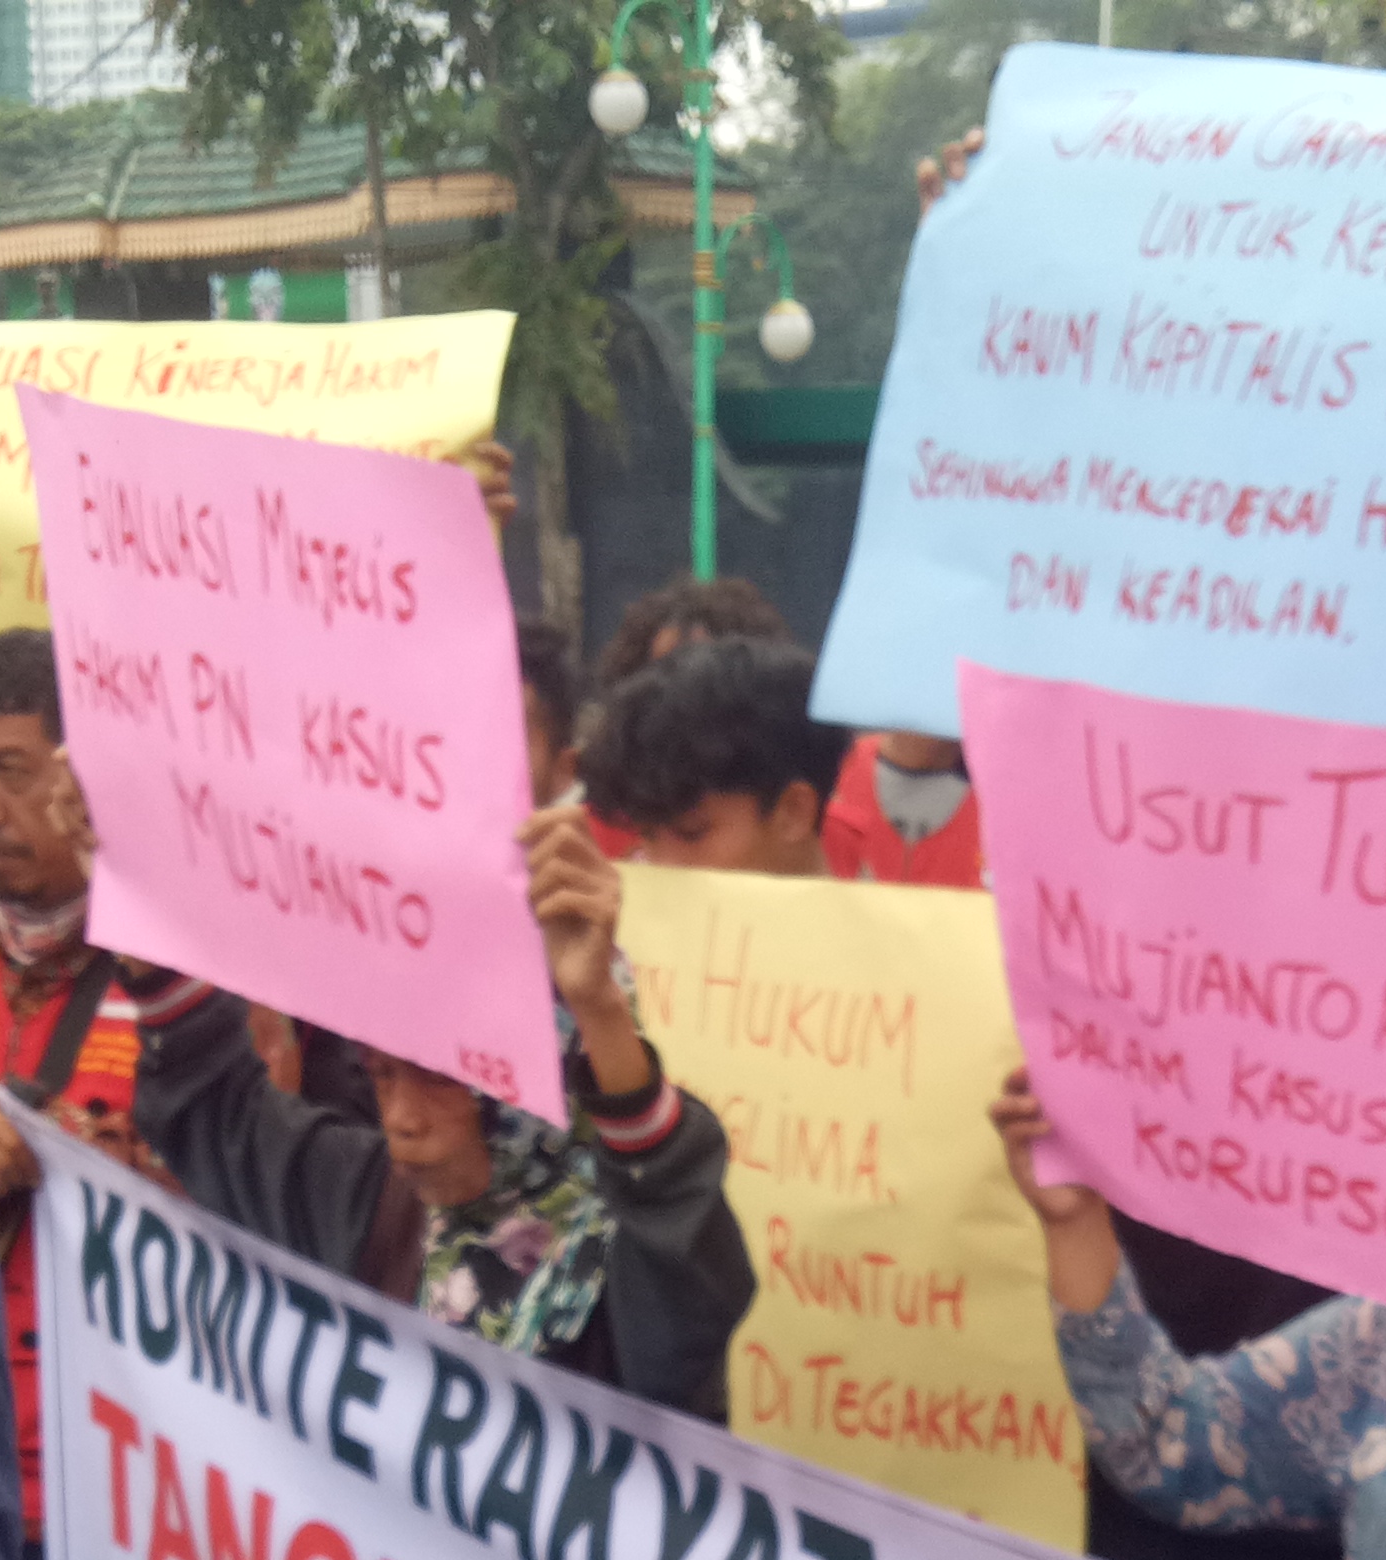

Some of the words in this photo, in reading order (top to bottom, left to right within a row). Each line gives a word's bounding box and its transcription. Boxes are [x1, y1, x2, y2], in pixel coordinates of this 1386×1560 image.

[1139, 190, 1315, 262] UNTUK
[976, 296, 1099, 386] KAUM
[1006, 551, 1091, 615] DAN
[188, 648, 256, 763] PN
[300, 690, 447, 812] KASUS
[1082, 718, 1291, 867] USUT
[696, 903, 917, 1099] HUKUM
[1034, 875, 1363, 1043] MUJIANTO
[80, 1178, 395, 1483] KOMITE
[766, 1213, 968, 1332] RUNTUH
